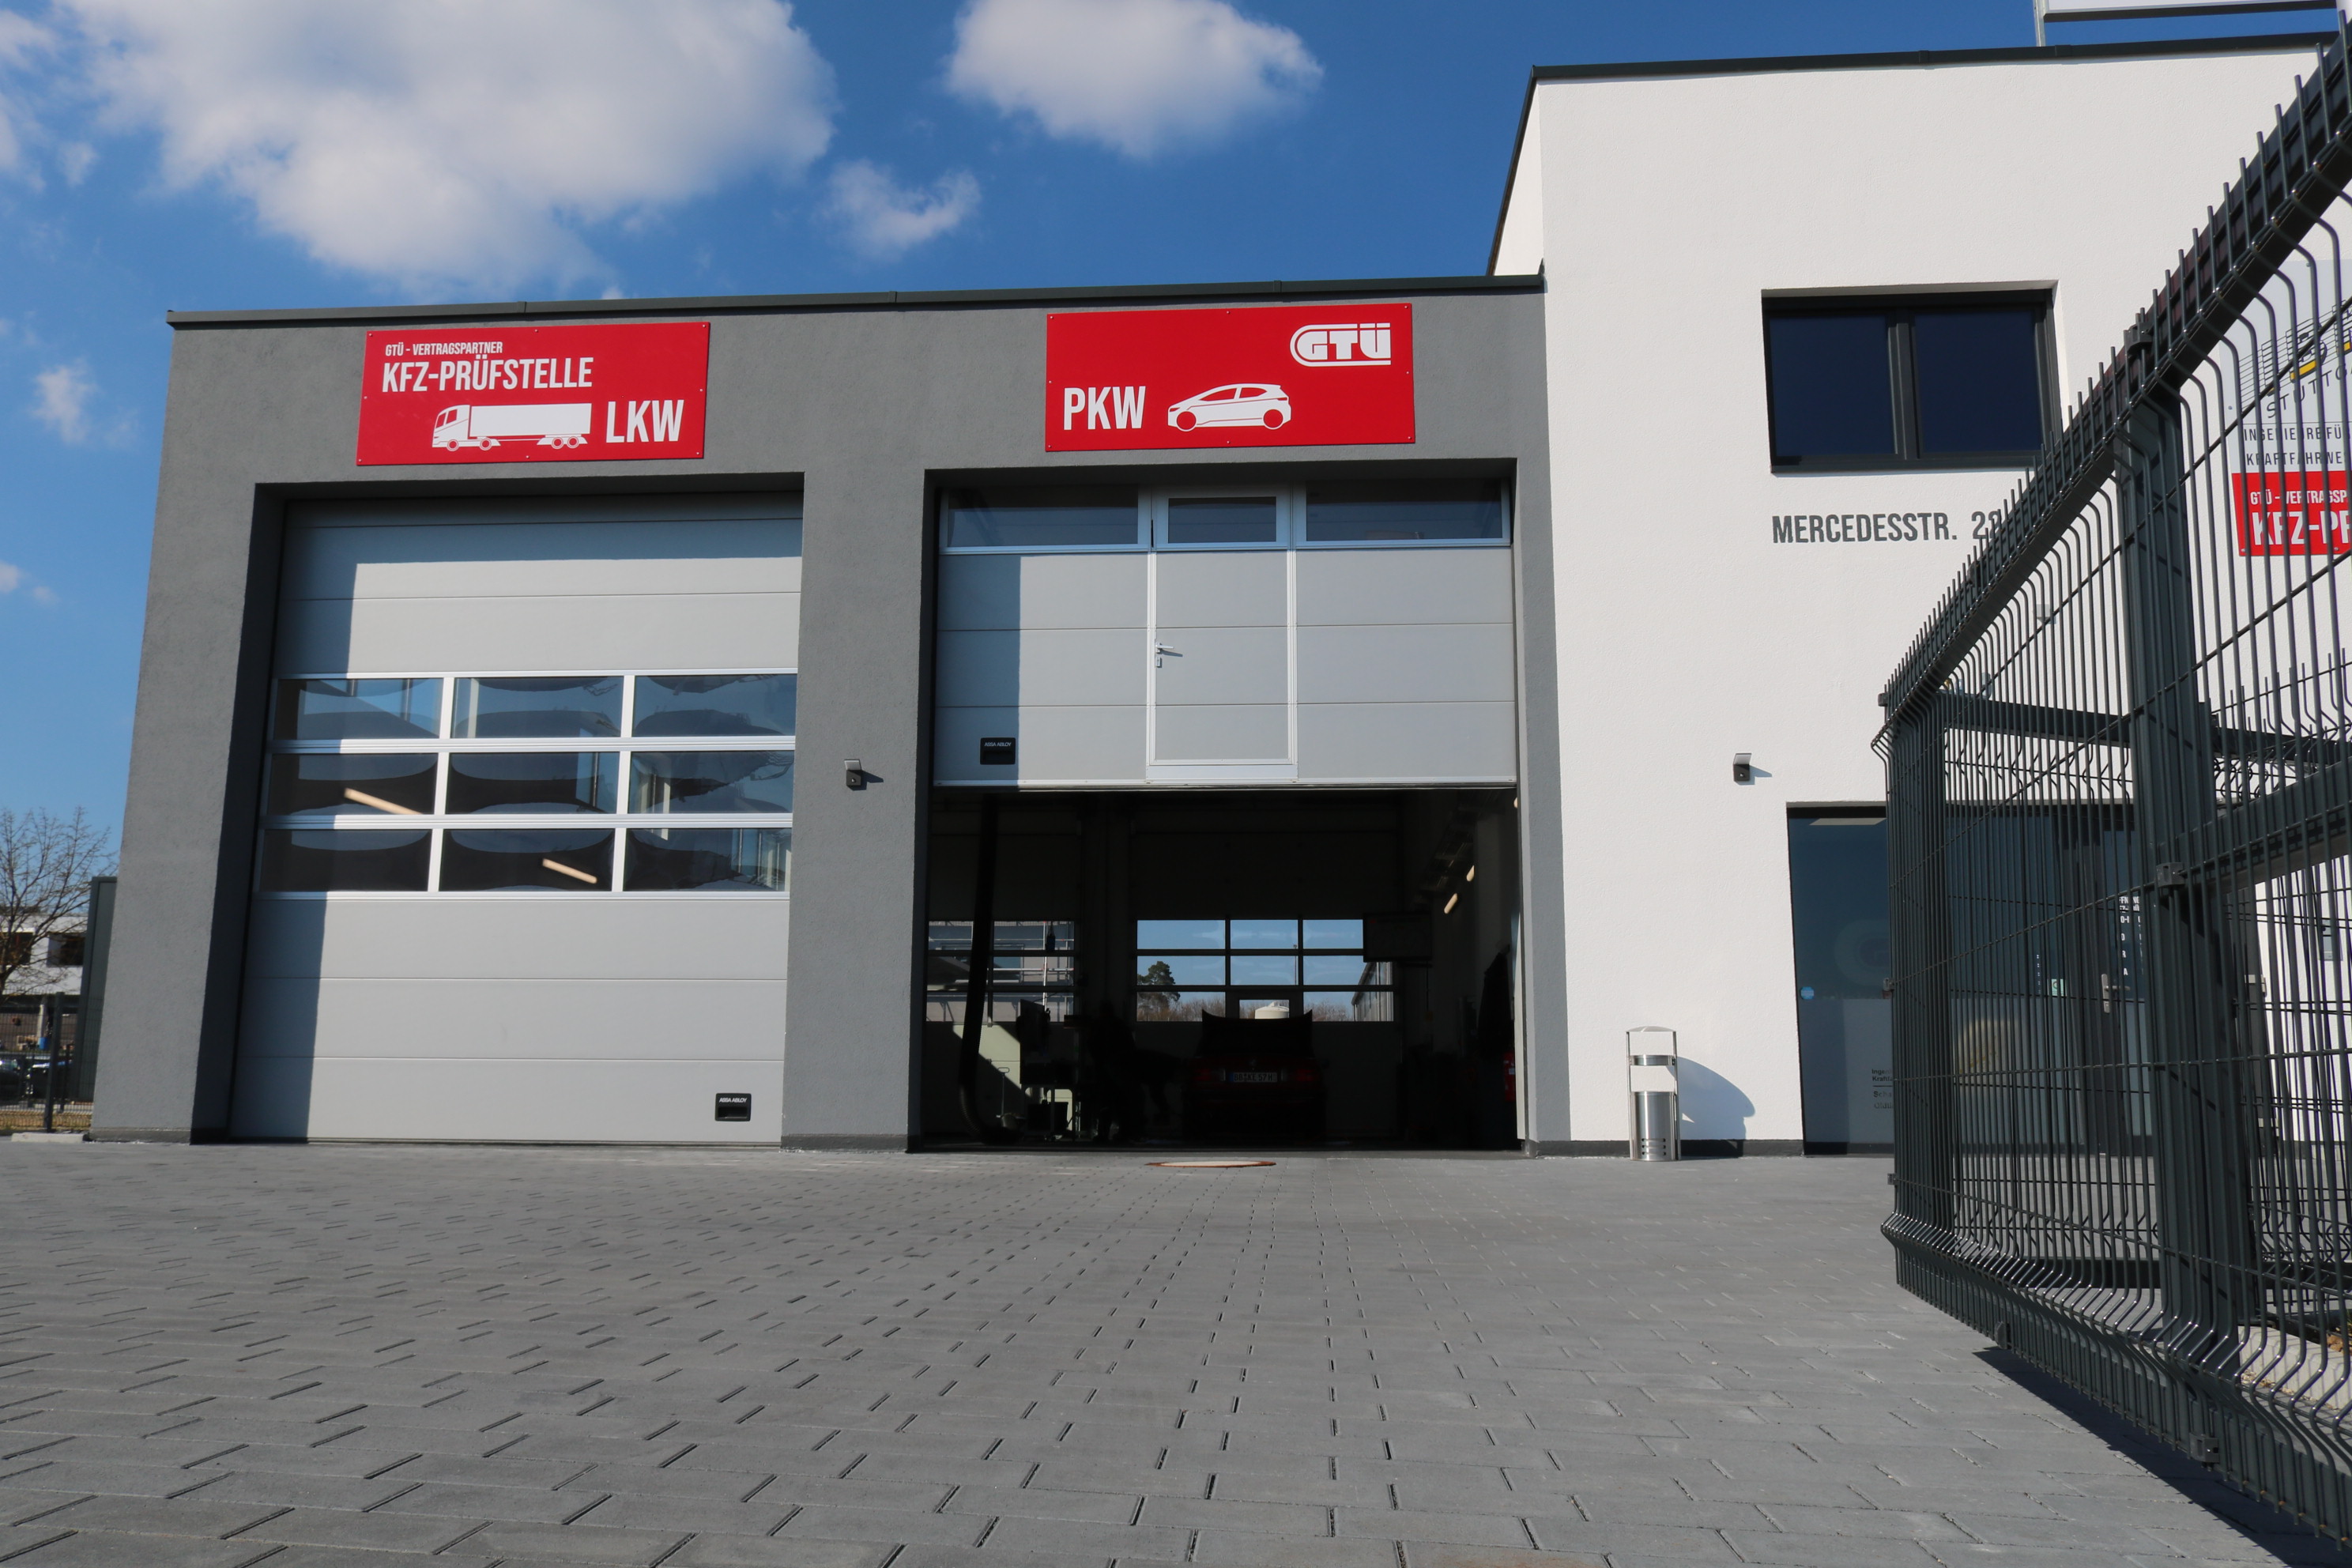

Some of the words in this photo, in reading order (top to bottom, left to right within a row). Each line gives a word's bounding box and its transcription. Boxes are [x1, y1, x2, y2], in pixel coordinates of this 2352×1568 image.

[385, 342, 404, 356] GTÜ
[413, 341, 503, 356] VERTRAGSPARTNER
[1294, 322, 1391, 362] GTÜ
[383, 355, 594, 392] KFZ-PRÜFSTELLE
[2267, 366, 2352, 418] STUTTG
[605, 400, 684, 443] LKW
[1064, 386, 1145, 431] PKW
[2244, 427, 2322, 441] INGEIERE
[2284, 489, 2348, 504] ERTRAGSP
[1772, 513, 1958, 544] MERCEDESSTR.
